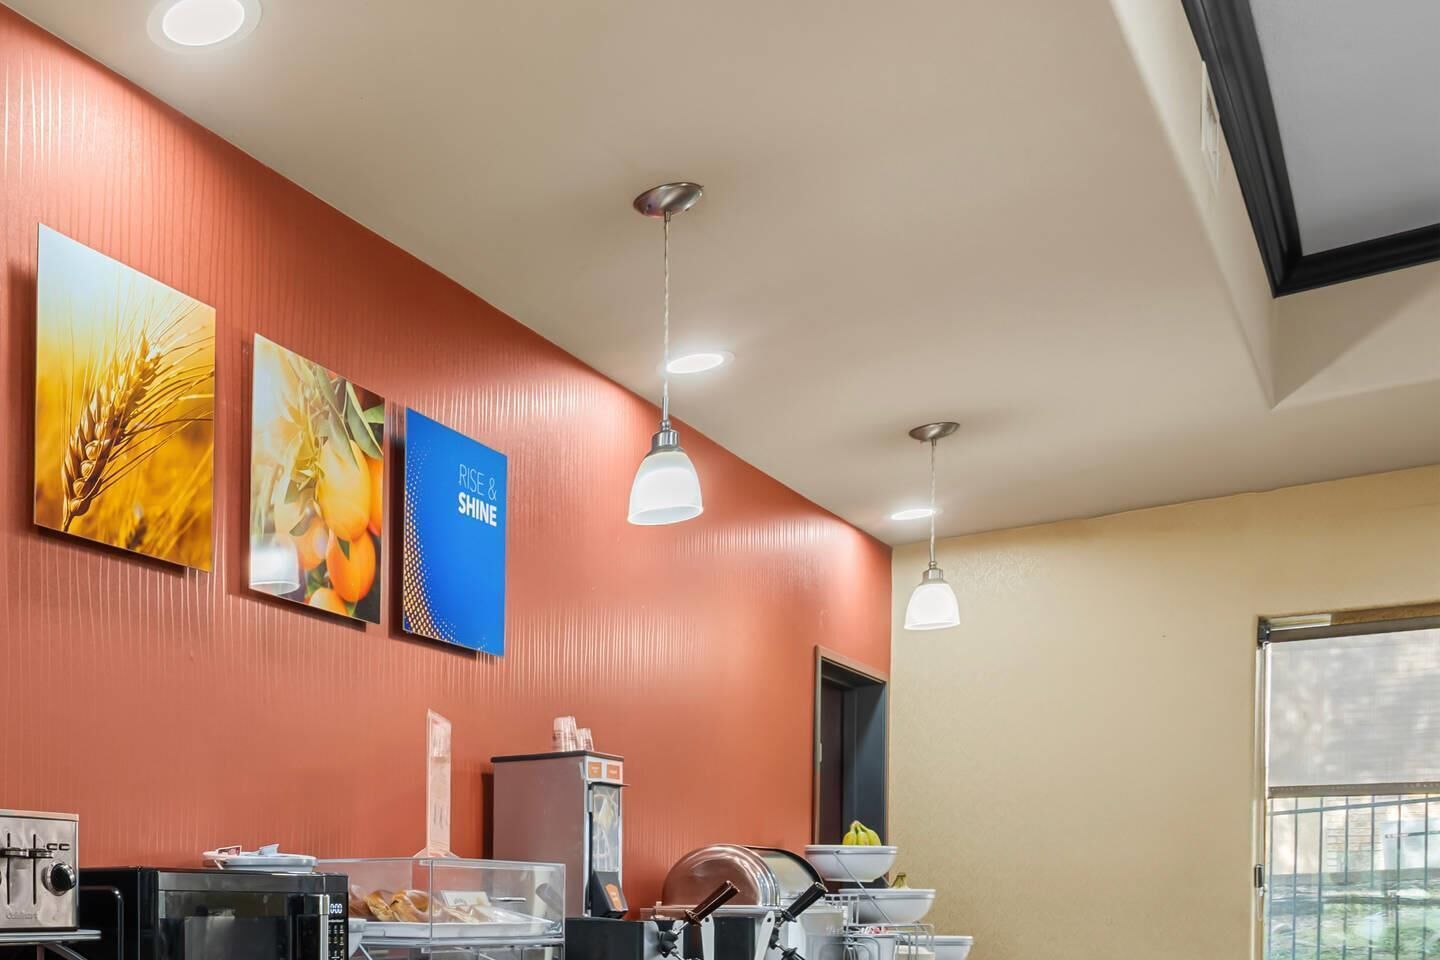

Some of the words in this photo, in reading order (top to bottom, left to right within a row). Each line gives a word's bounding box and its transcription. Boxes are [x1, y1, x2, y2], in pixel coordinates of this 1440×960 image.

[459, 464, 485, 496] RISE
[488, 477, 497, 501] &
[458, 491, 497, 527] SHINE
